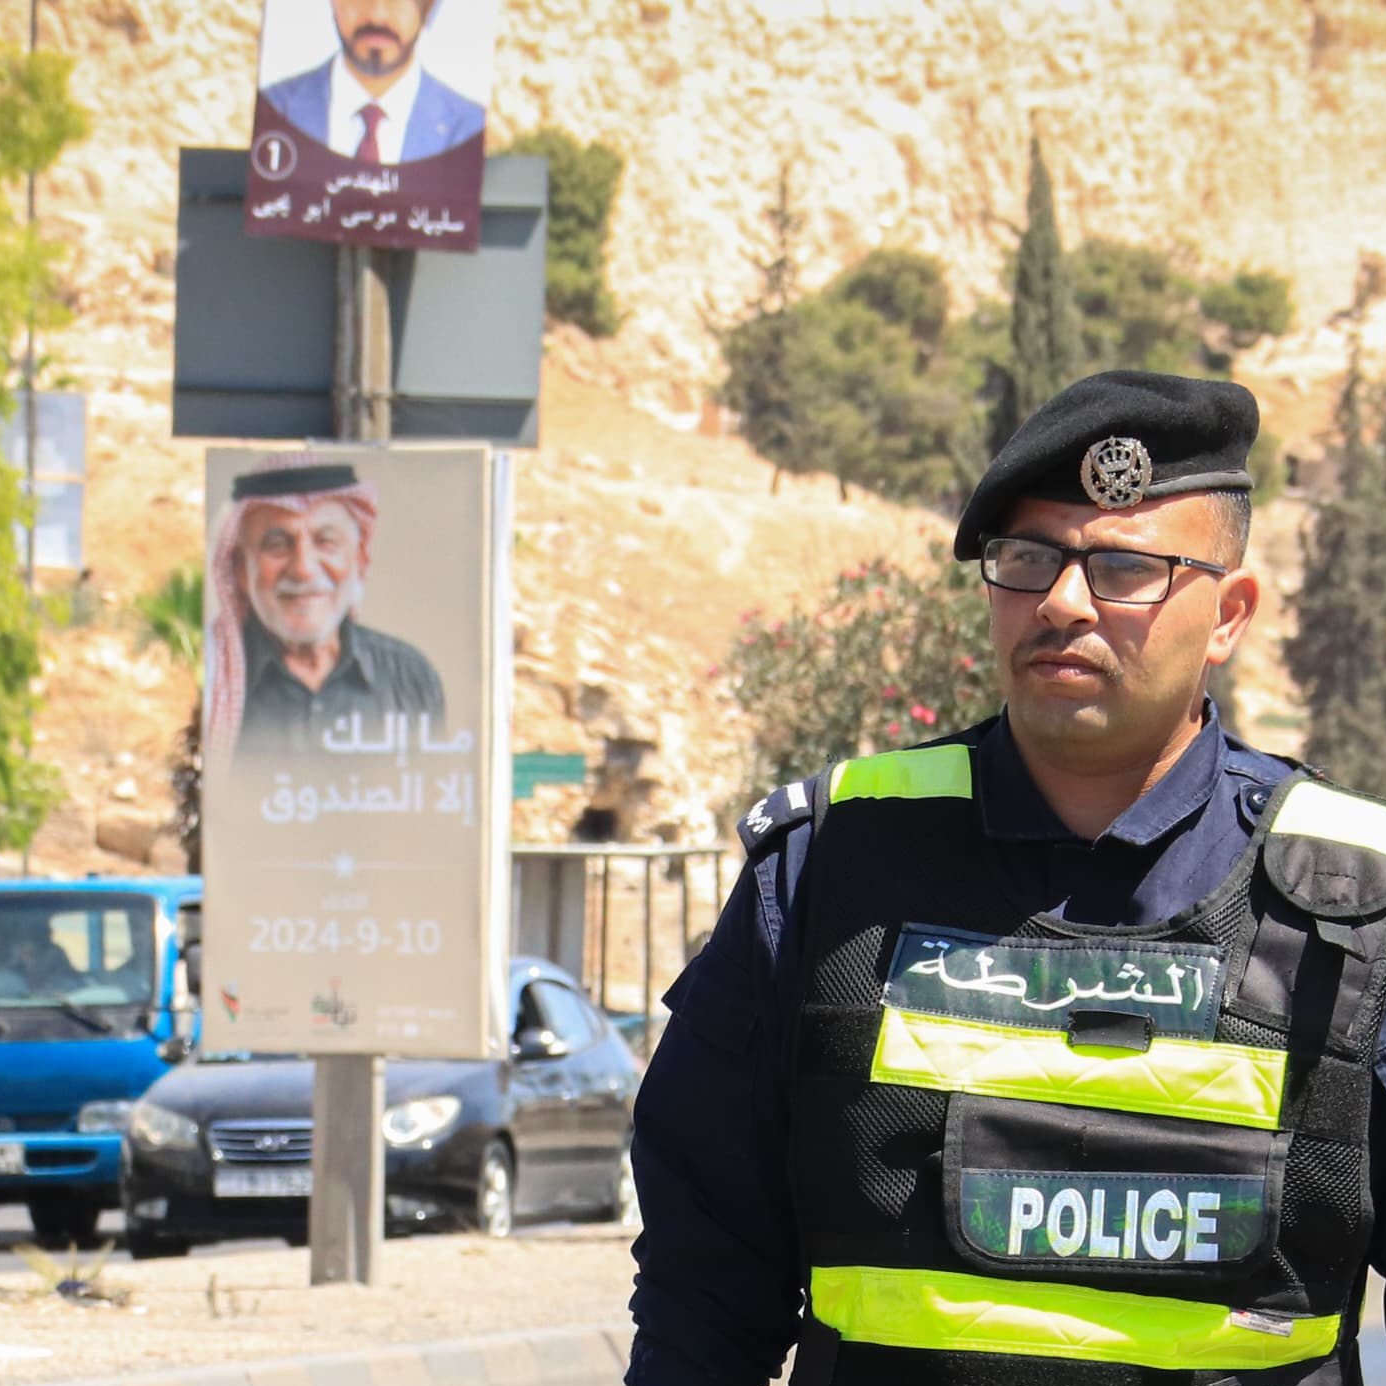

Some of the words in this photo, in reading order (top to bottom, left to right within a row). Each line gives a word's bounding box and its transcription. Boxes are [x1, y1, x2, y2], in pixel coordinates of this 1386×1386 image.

[325, 168, 399, 197] المهندس
[340, 210, 397, 231] موسى
[408, 207, 465, 236] سليمان
[322, 711, 408, 767] إلك
[419, 712, 474, 753] ما
[261, 771, 424, 823] الصندوق
[436, 772, 475, 827] إلا
[248, 917, 442, 955] 2024-9-10
[907, 939, 1205, 1011] الشرطة
[1007, 1187, 1221, 1262] POLICE
